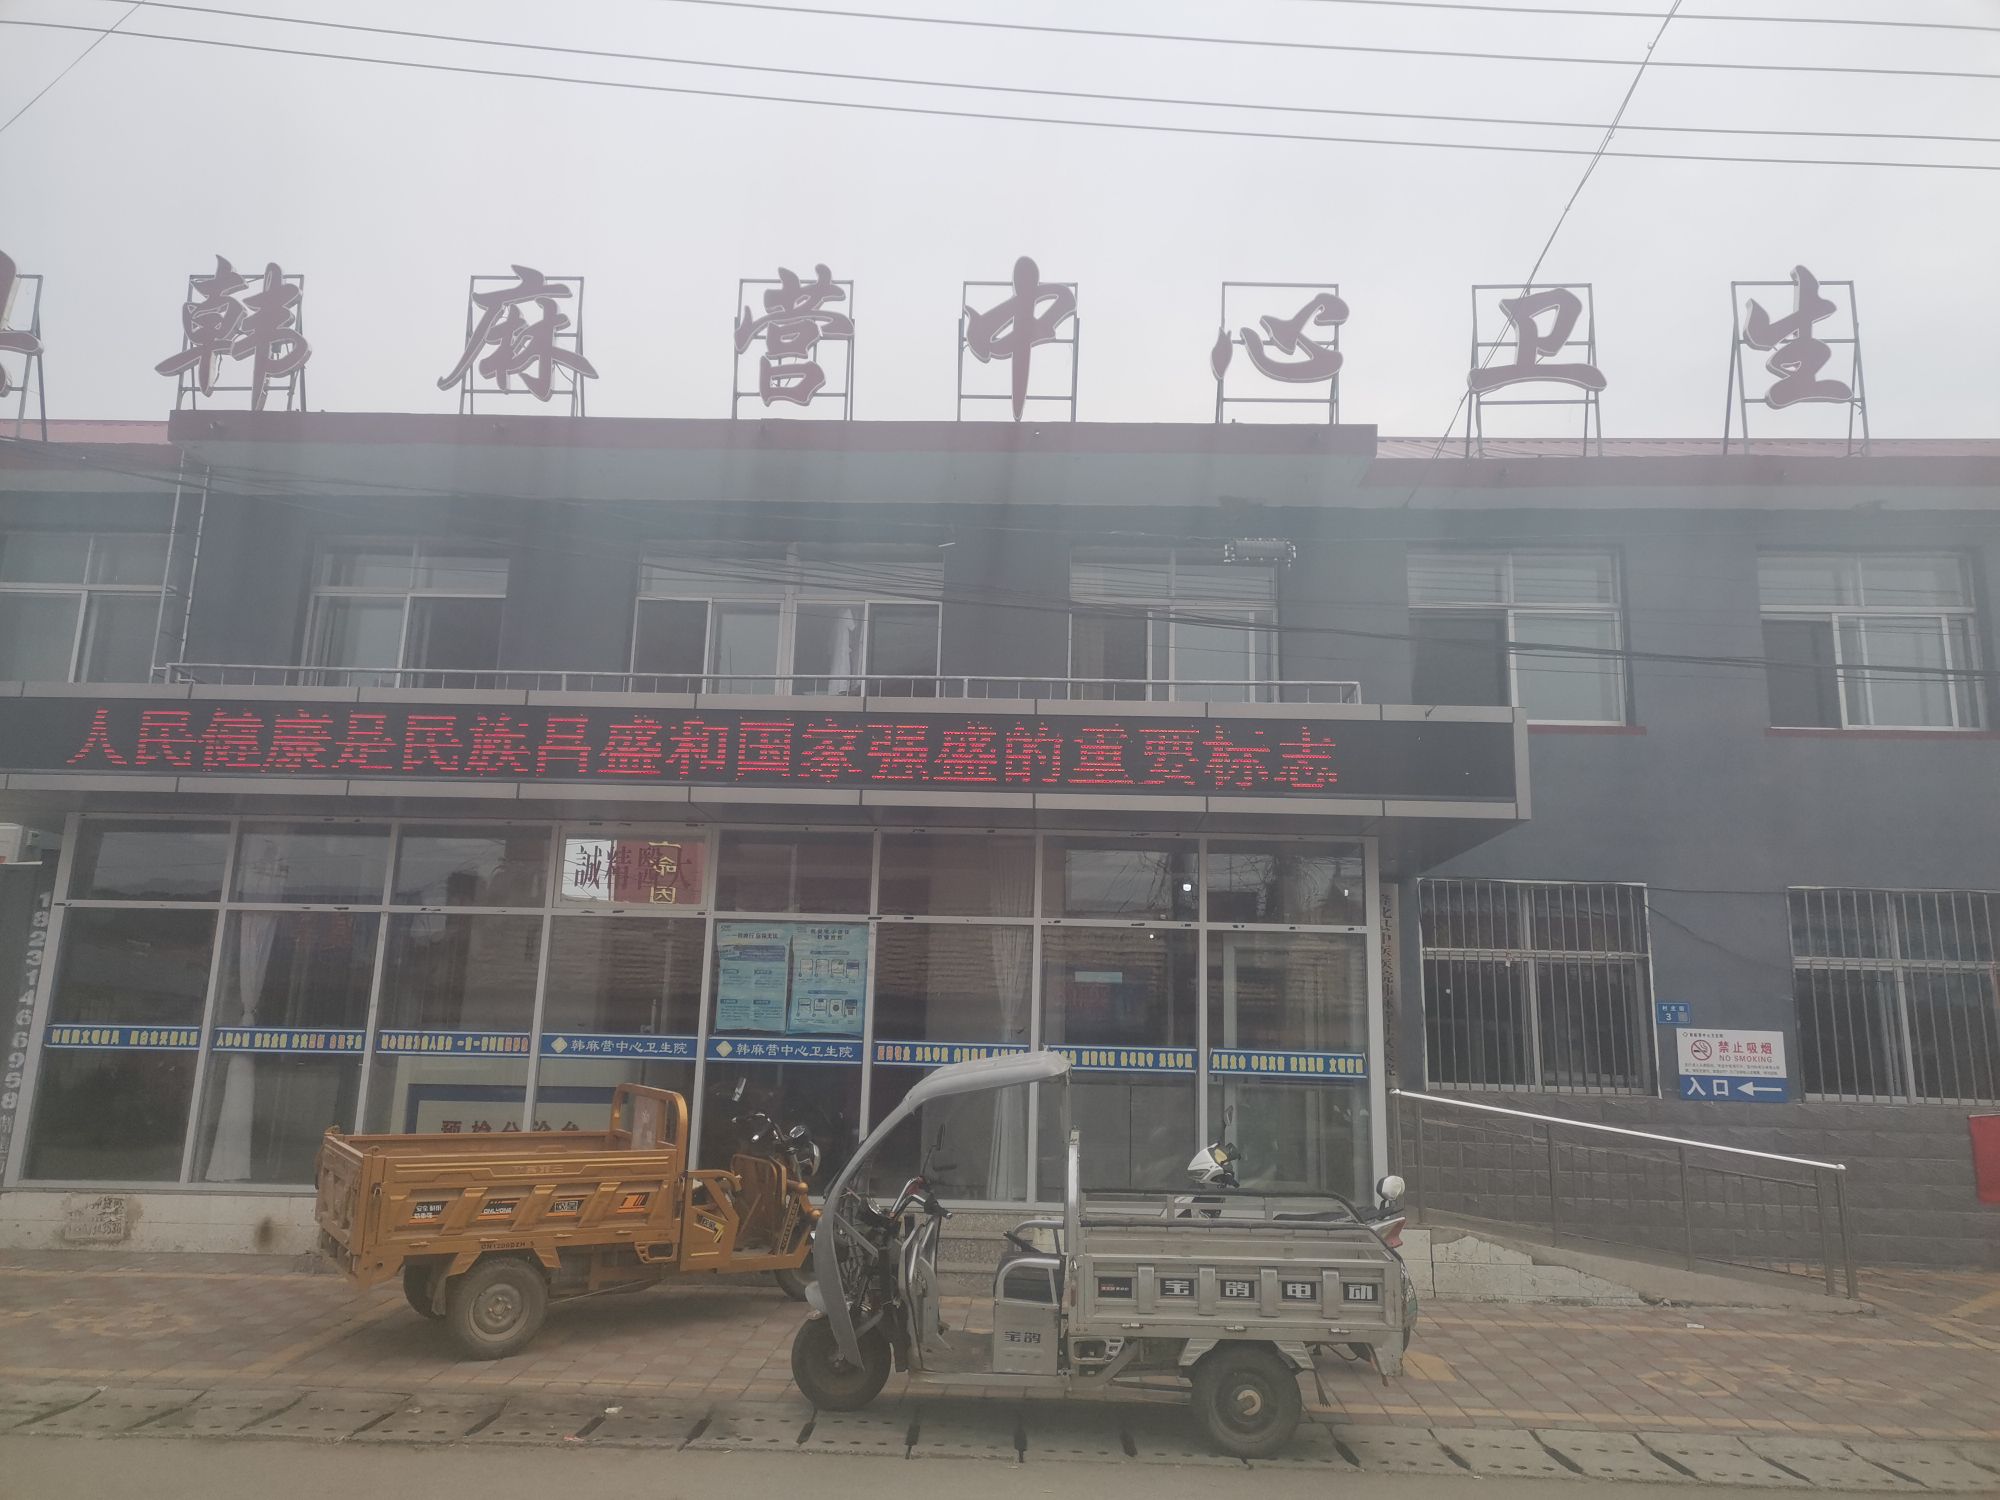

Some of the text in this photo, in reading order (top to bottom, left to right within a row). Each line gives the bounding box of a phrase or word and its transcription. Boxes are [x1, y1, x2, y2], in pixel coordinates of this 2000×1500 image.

[66, 708, 1337, 789] 人民健康是民族昌盛和国家强盛的重要标志
[570, 1039, 688, 1055] 韩麻营中心卫生院
[735, 1043, 854, 1058] 韩麻营中心卫生院
[1718, 1040, 1772, 1055] 禁止吸烟
[1734, 1055, 1773, 1063] SMOKING
[1687, 1077, 1729, 1096] 入口
